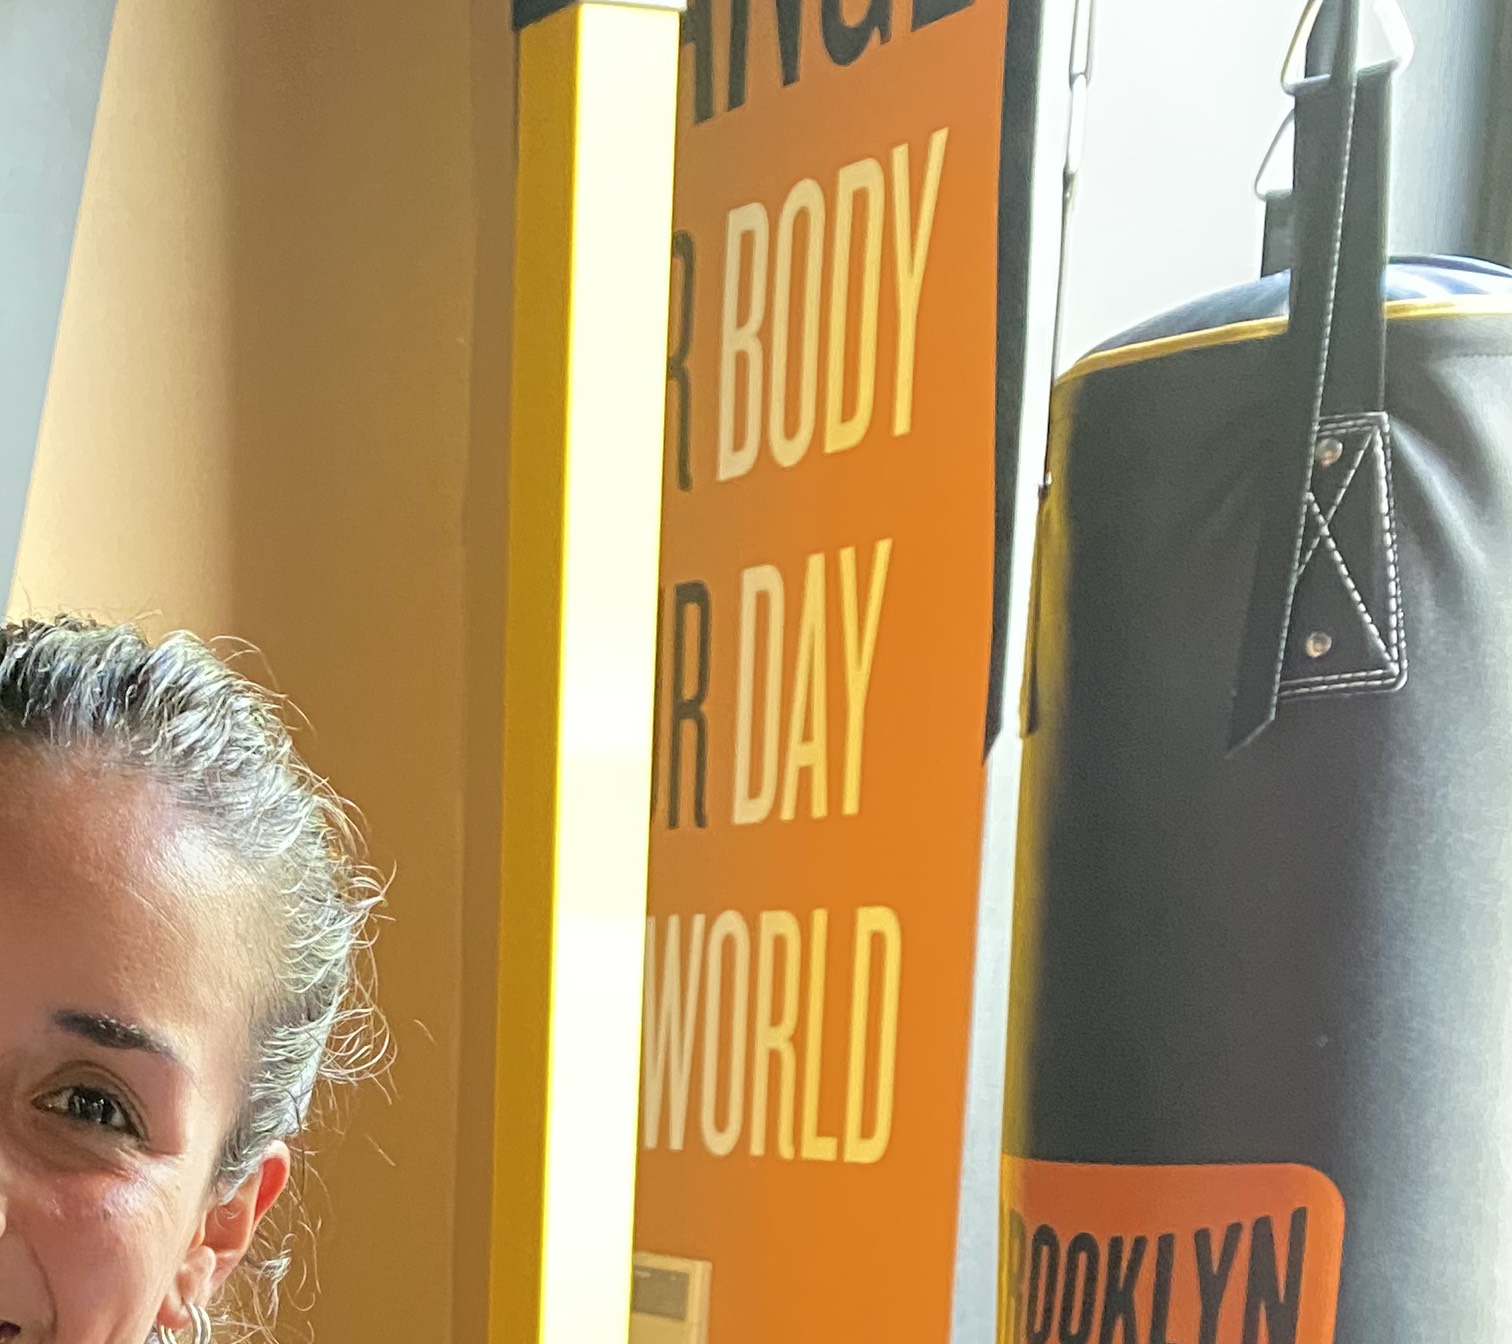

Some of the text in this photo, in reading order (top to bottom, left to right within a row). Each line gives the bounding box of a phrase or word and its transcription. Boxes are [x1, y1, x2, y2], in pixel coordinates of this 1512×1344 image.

[717, 127, 950, 483] BODY
[732, 537, 893, 826] DAY
[642, 905, 902, 1165] WORLD
